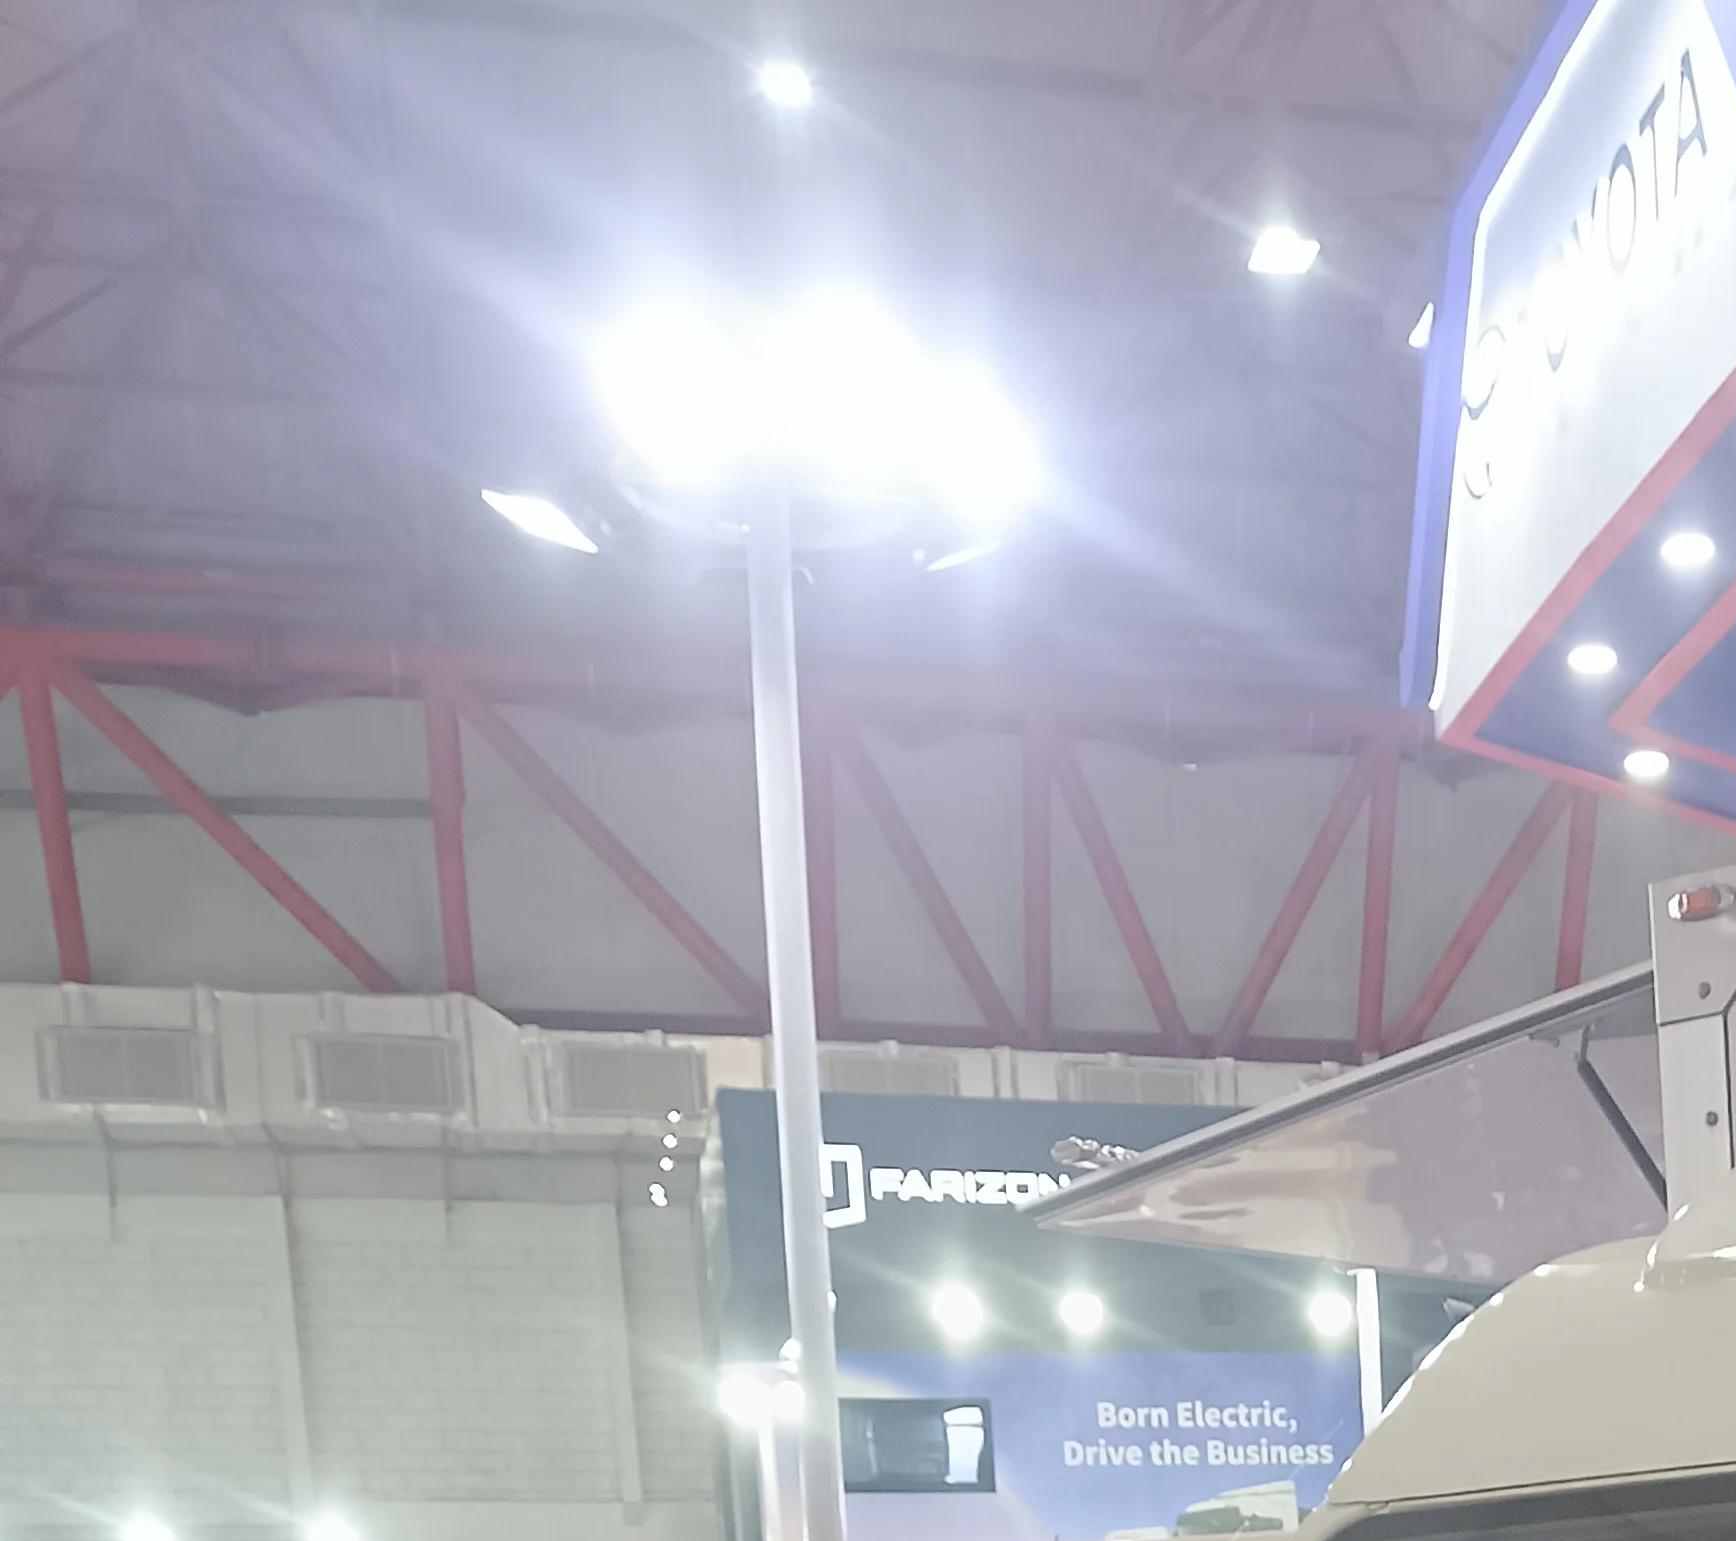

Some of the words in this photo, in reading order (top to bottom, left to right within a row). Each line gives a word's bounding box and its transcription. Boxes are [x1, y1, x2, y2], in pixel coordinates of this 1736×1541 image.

[869, 1166, 1071, 1205] FARIZON
[1096, 1401, 1169, 1428] Born
[1176, 1400, 1298, 1433] Electric,
[1063, 1438, 1143, 1466] Drive
[1150, 1438, 1200, 1465] the
[1206, 1438, 1334, 1465] Business
